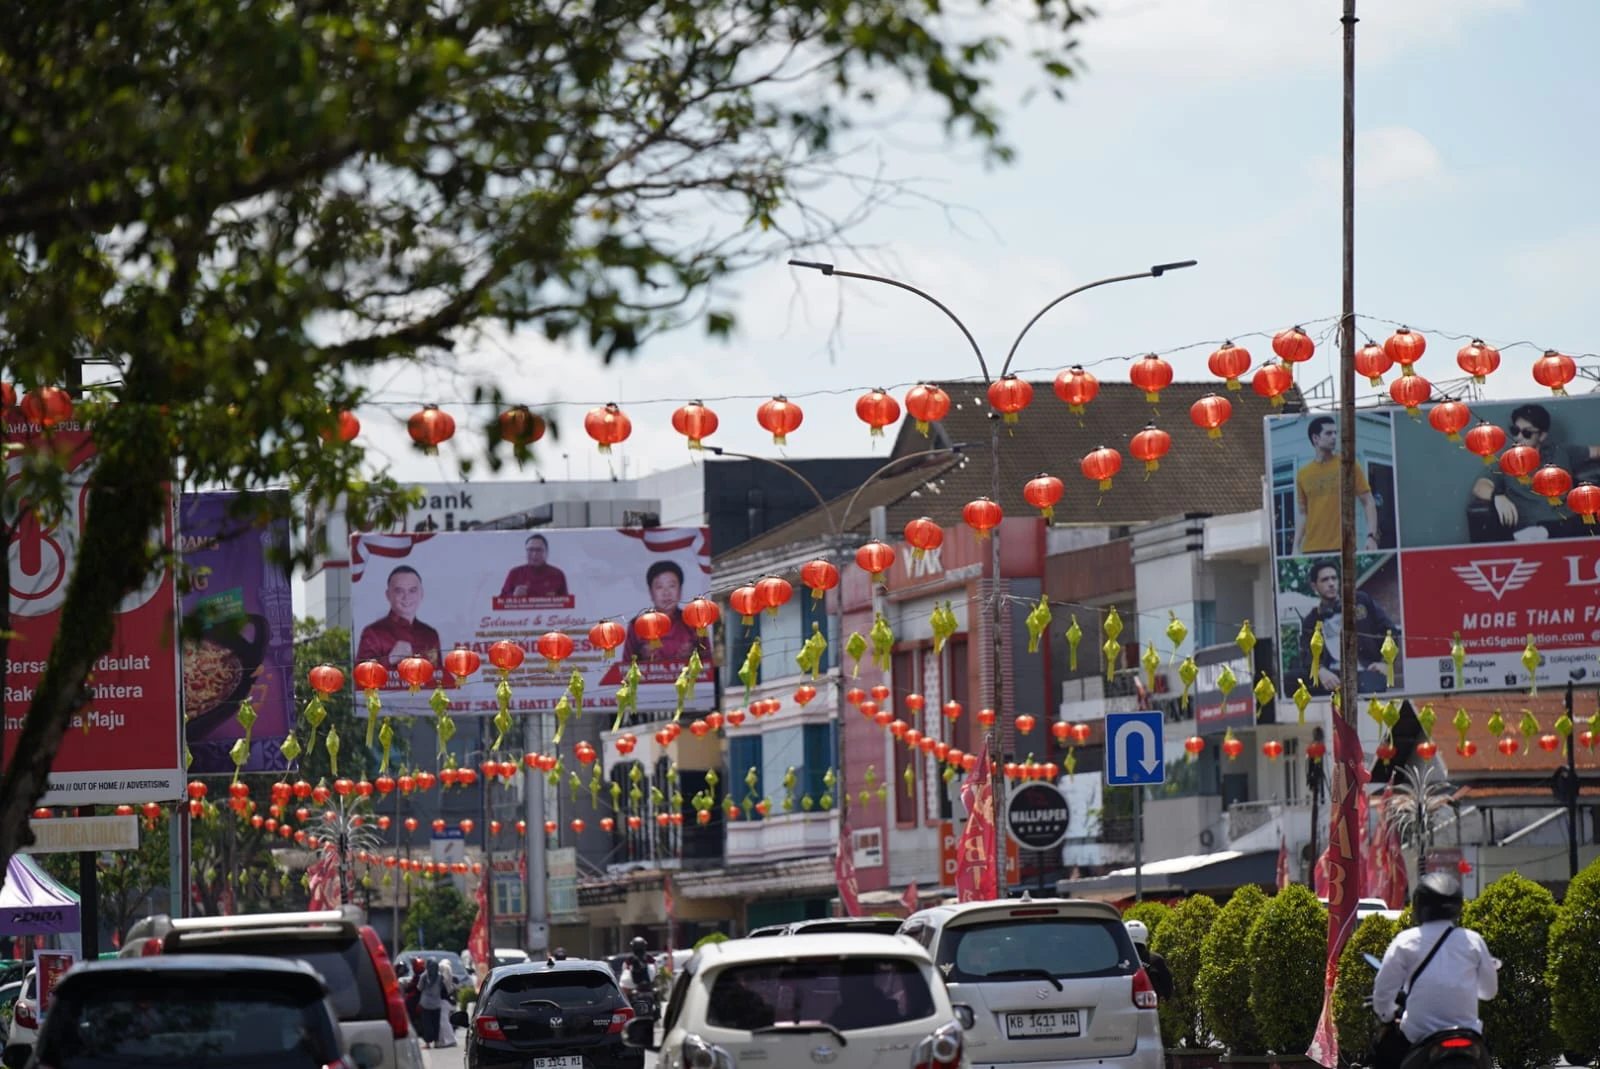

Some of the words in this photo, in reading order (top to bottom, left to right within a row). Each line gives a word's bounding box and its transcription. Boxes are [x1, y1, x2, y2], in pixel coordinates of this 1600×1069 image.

[1463, 612, 1517, 630] MORE
[1526, 608, 1574, 626] THAN
[5, 658, 49, 674] Bersa
[87, 710, 125, 730] Maju
[73, 782, 87, 792] OUT
[88, 781, 98, 791] OF
[99, 780, 118, 791] HOME
[126, 779, 170, 790] ADVERTISING
[1010, 1015, 1023, 1029] KB
